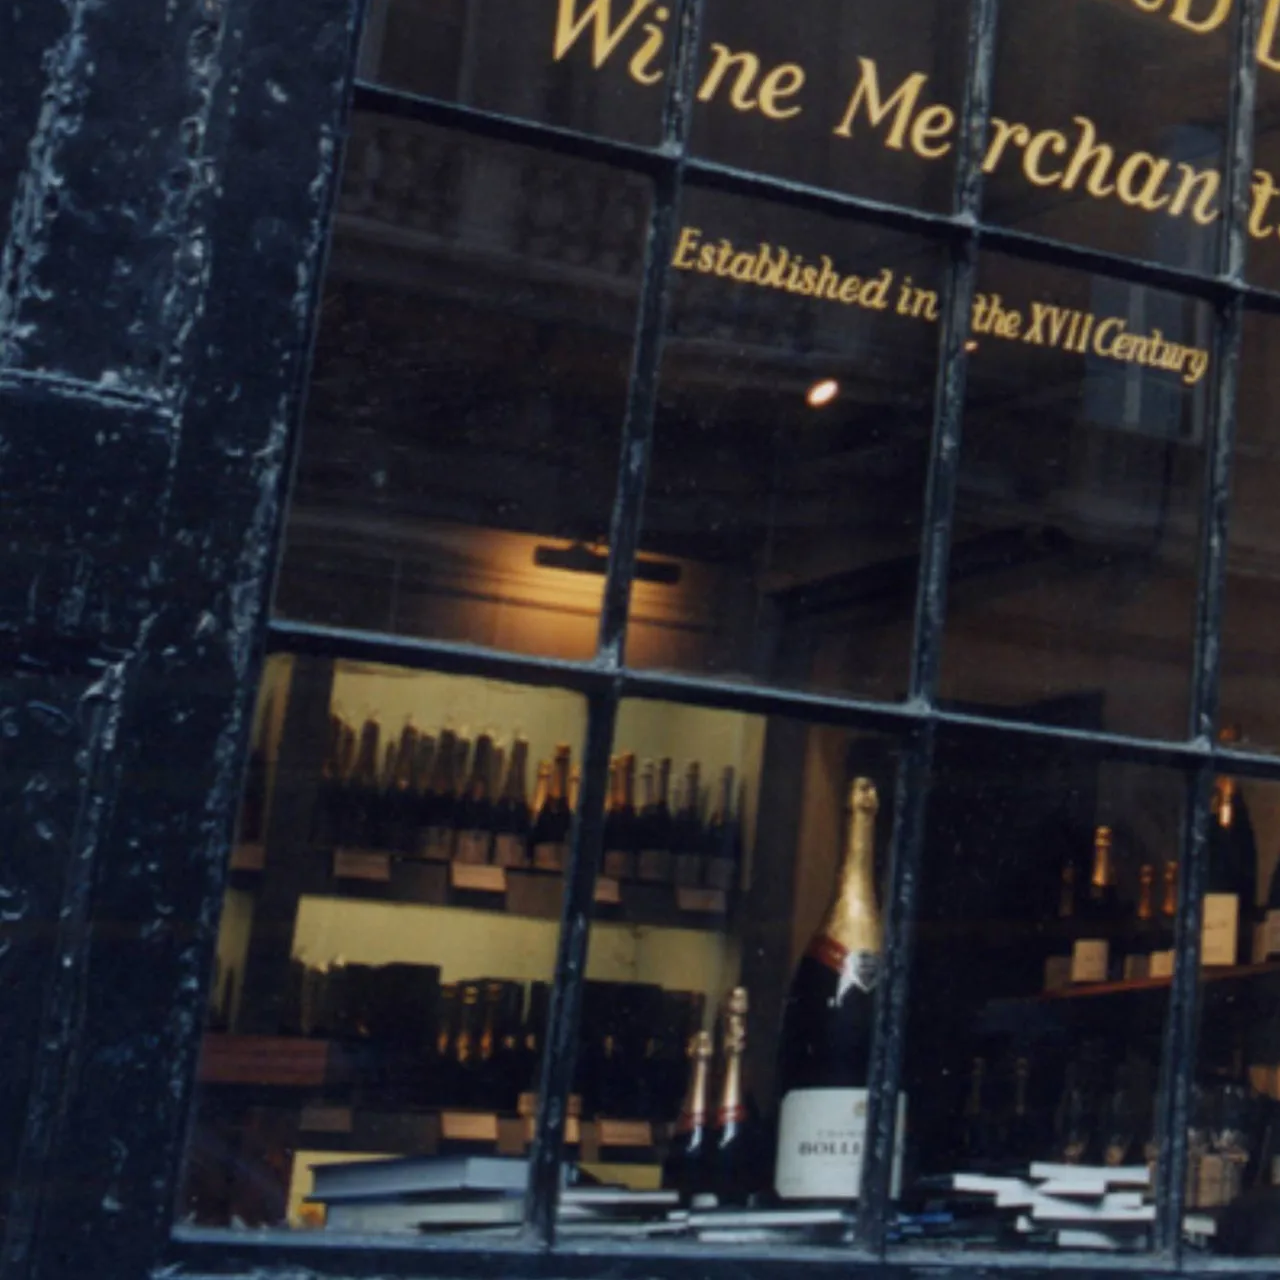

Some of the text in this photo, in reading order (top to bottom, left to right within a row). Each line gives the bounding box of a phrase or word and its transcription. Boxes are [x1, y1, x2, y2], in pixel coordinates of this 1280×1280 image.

[672, 227, 1209, 384] Established in the XVII Century
